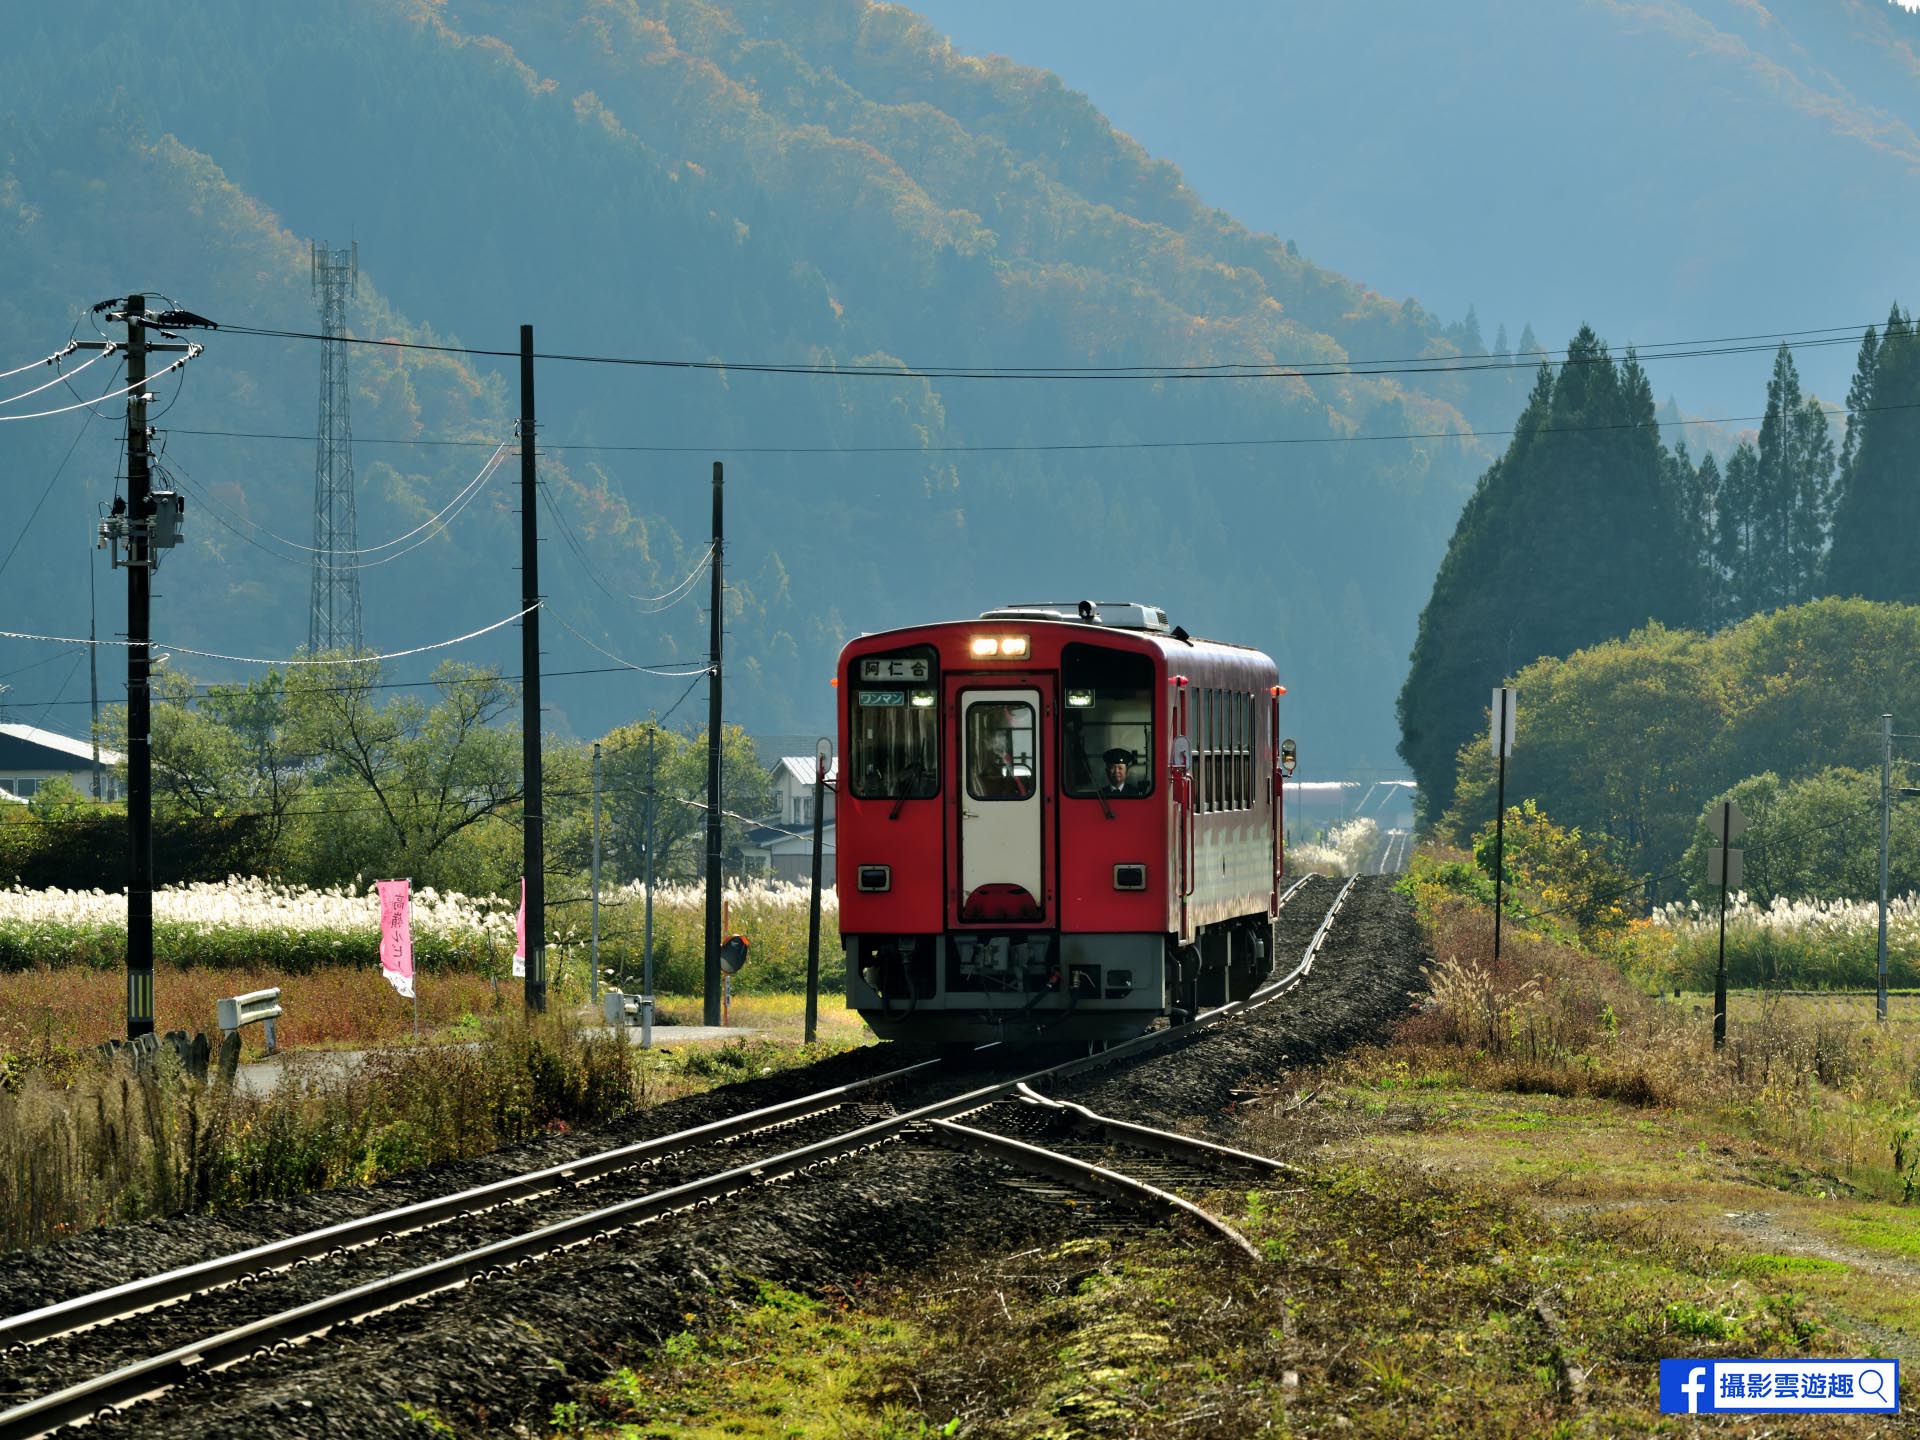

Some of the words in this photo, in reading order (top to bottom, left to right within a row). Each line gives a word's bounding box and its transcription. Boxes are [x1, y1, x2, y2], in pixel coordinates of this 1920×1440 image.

[865, 661, 926, 676] 阿仁合
[861, 694, 902, 704] ワンマン
